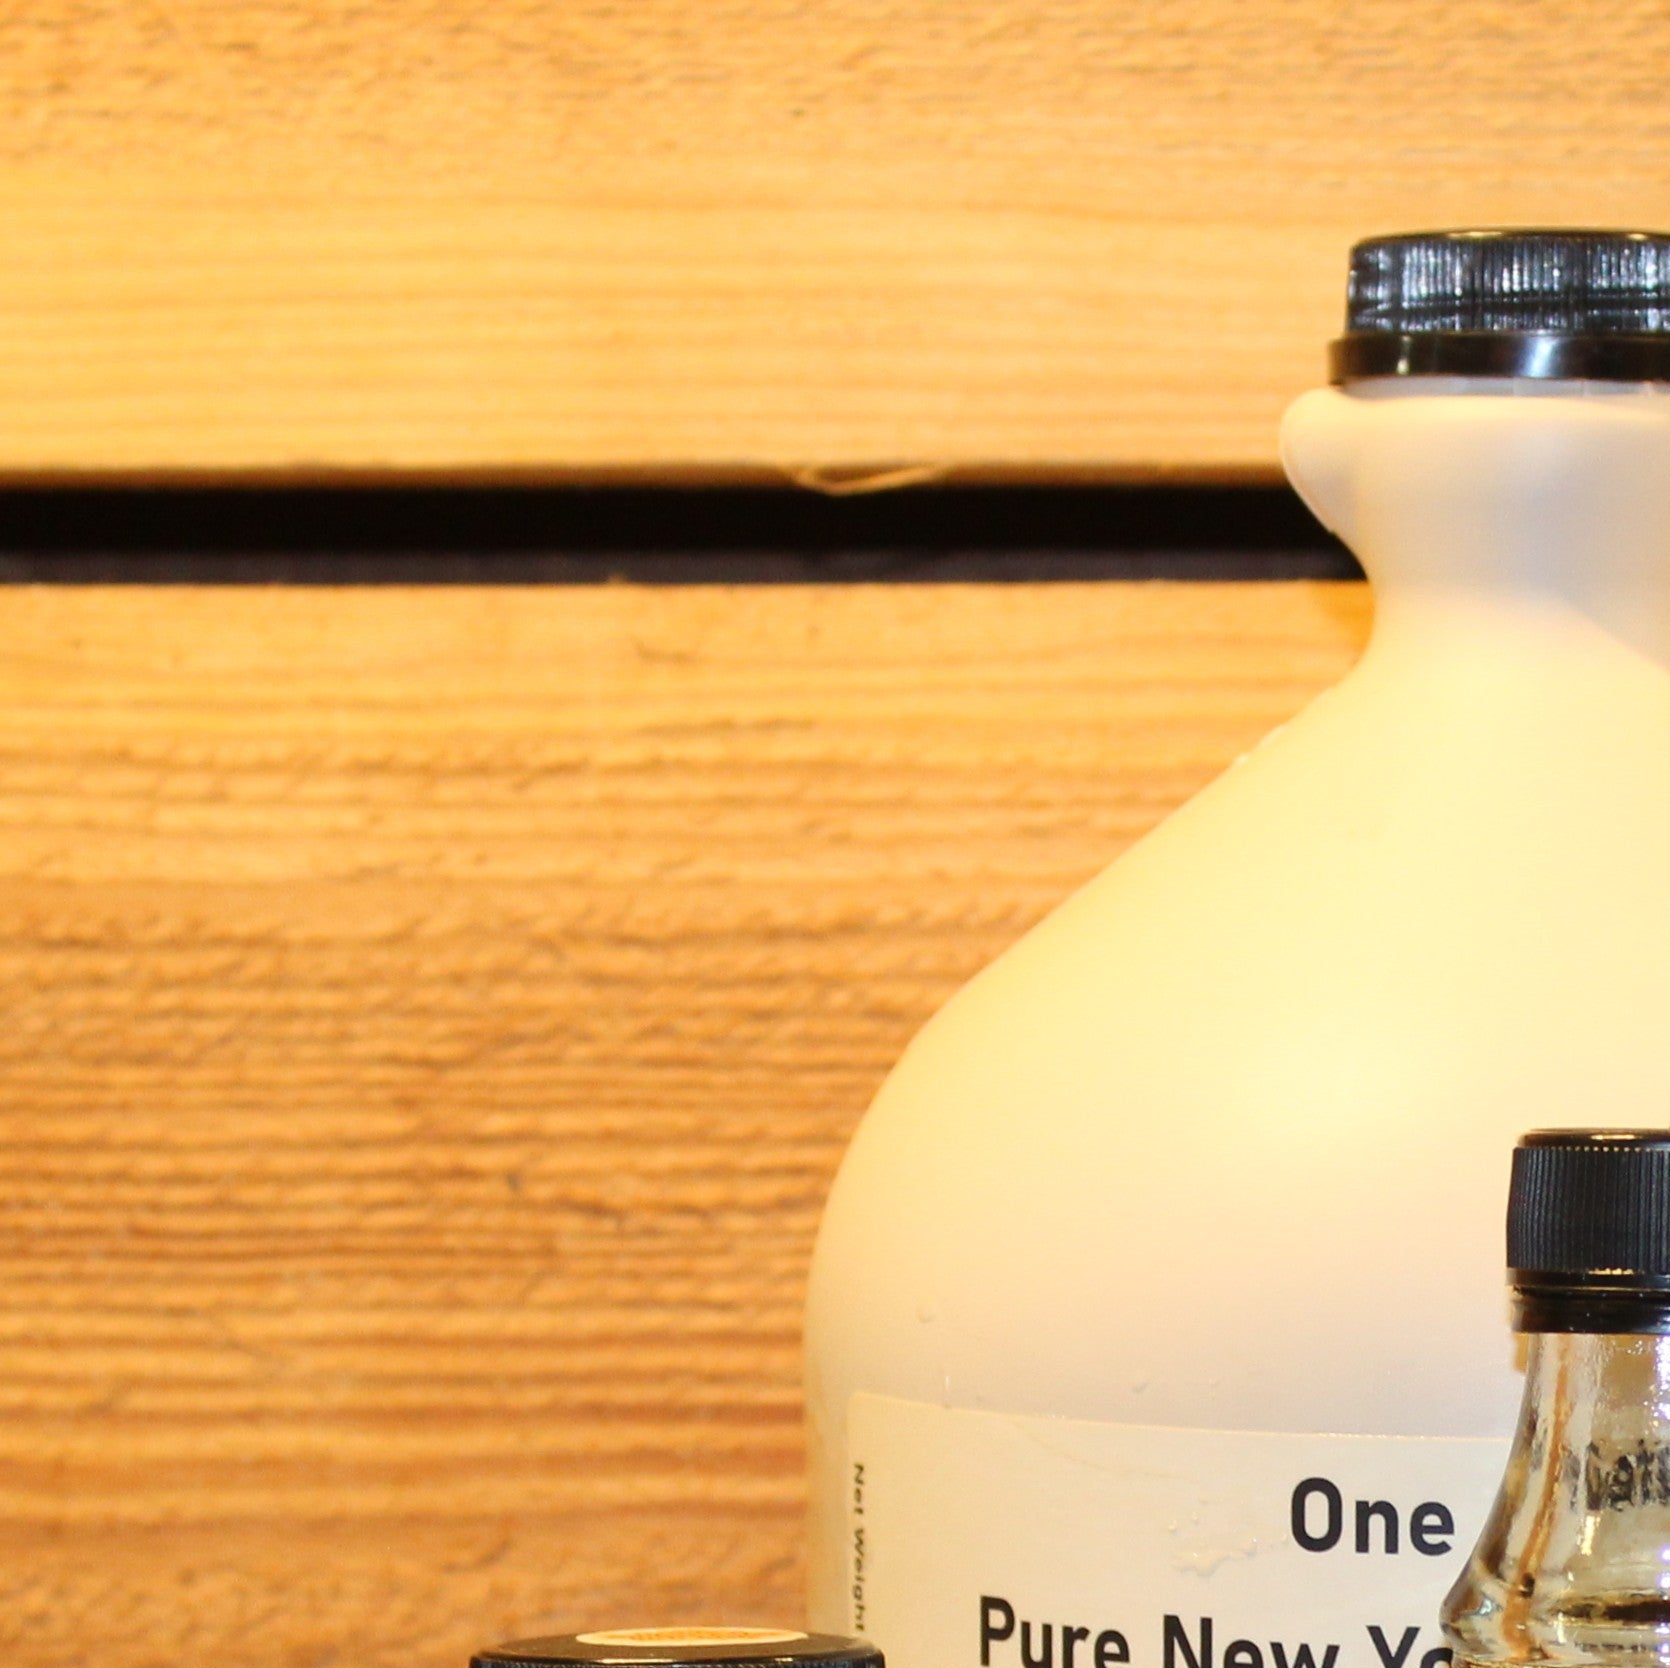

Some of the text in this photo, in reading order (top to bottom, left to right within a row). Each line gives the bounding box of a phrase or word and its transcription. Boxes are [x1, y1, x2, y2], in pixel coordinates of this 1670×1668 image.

[853, 1461, 866, 1632] Net Weight
[1289, 1476, 1455, 1555] One
